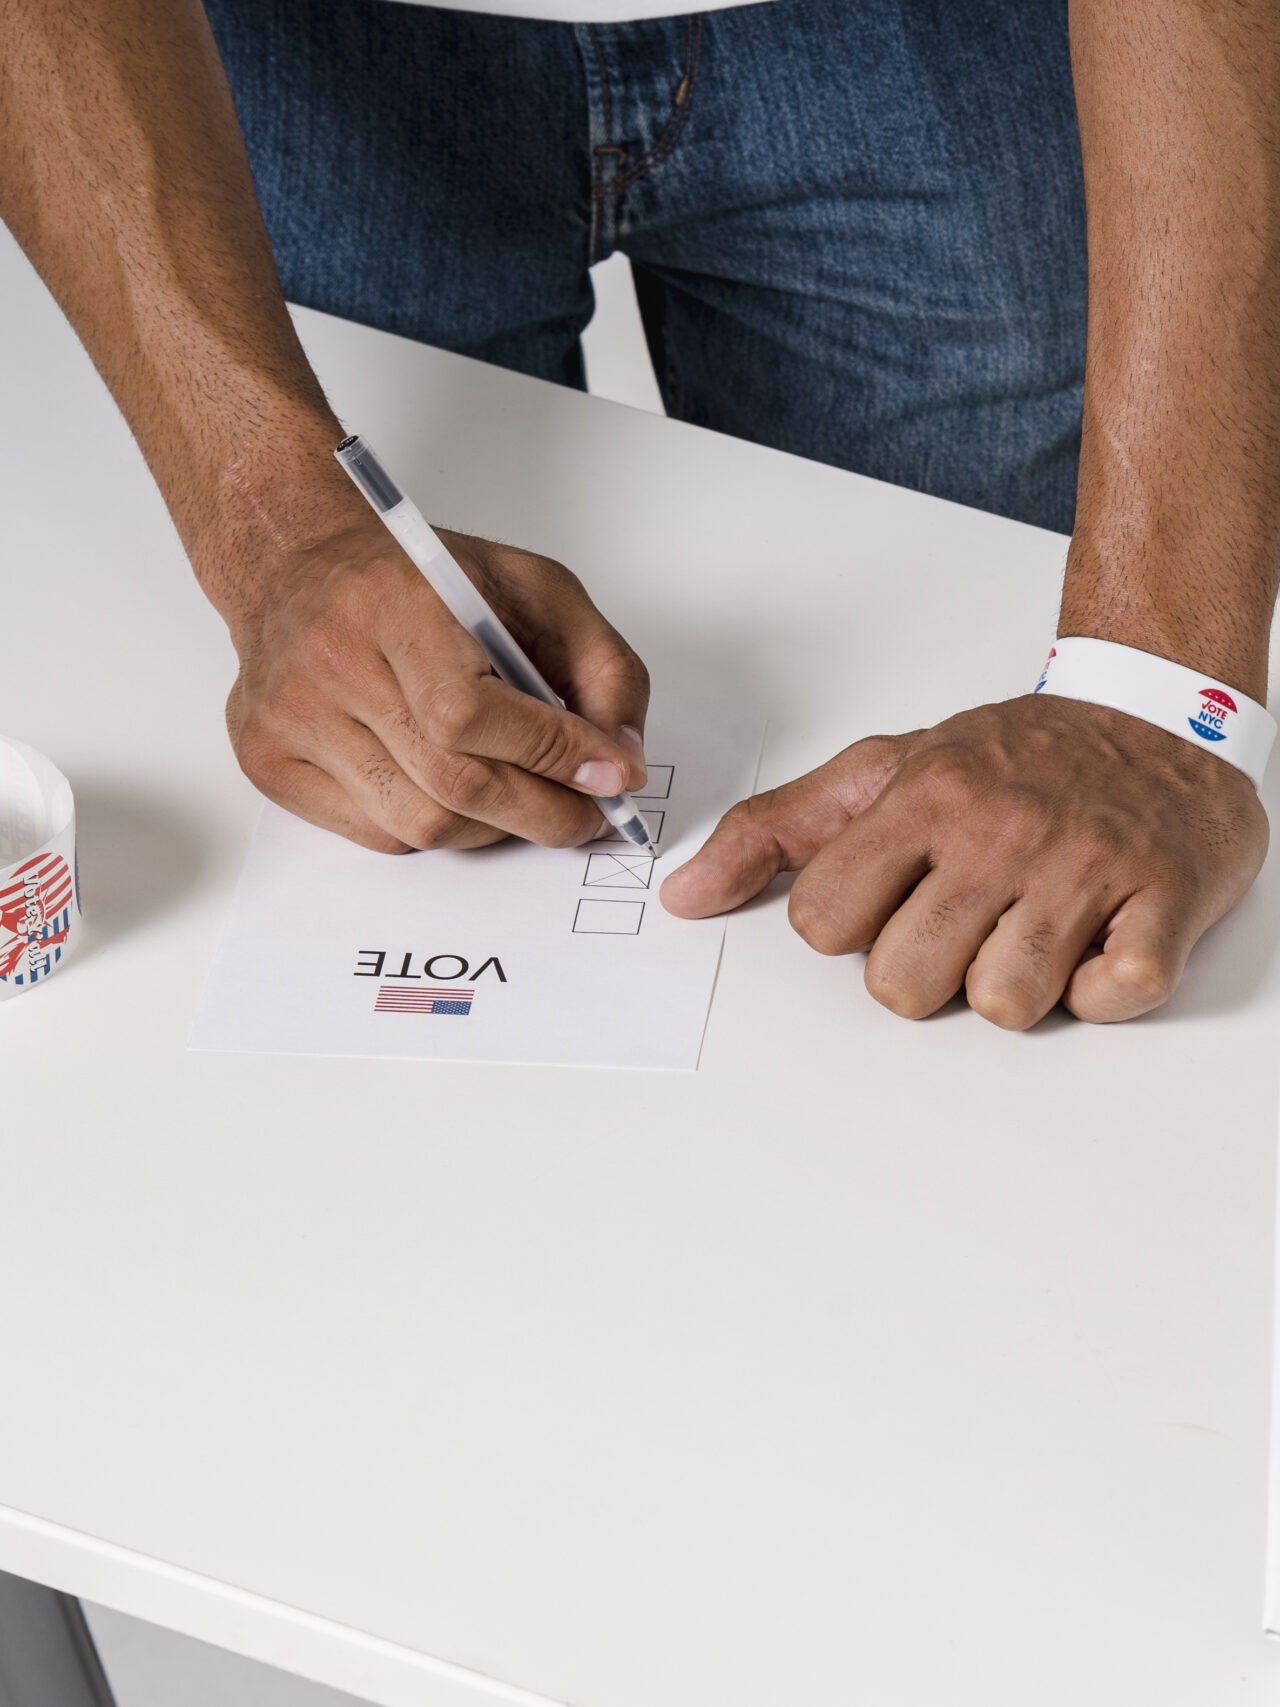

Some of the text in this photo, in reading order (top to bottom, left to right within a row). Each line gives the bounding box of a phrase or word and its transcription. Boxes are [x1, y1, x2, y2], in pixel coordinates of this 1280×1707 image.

[1198, 711, 1223, 729] NYC
[1201, 700, 1228, 720] VOTE
[353, 950, 508, 982] VOTE
